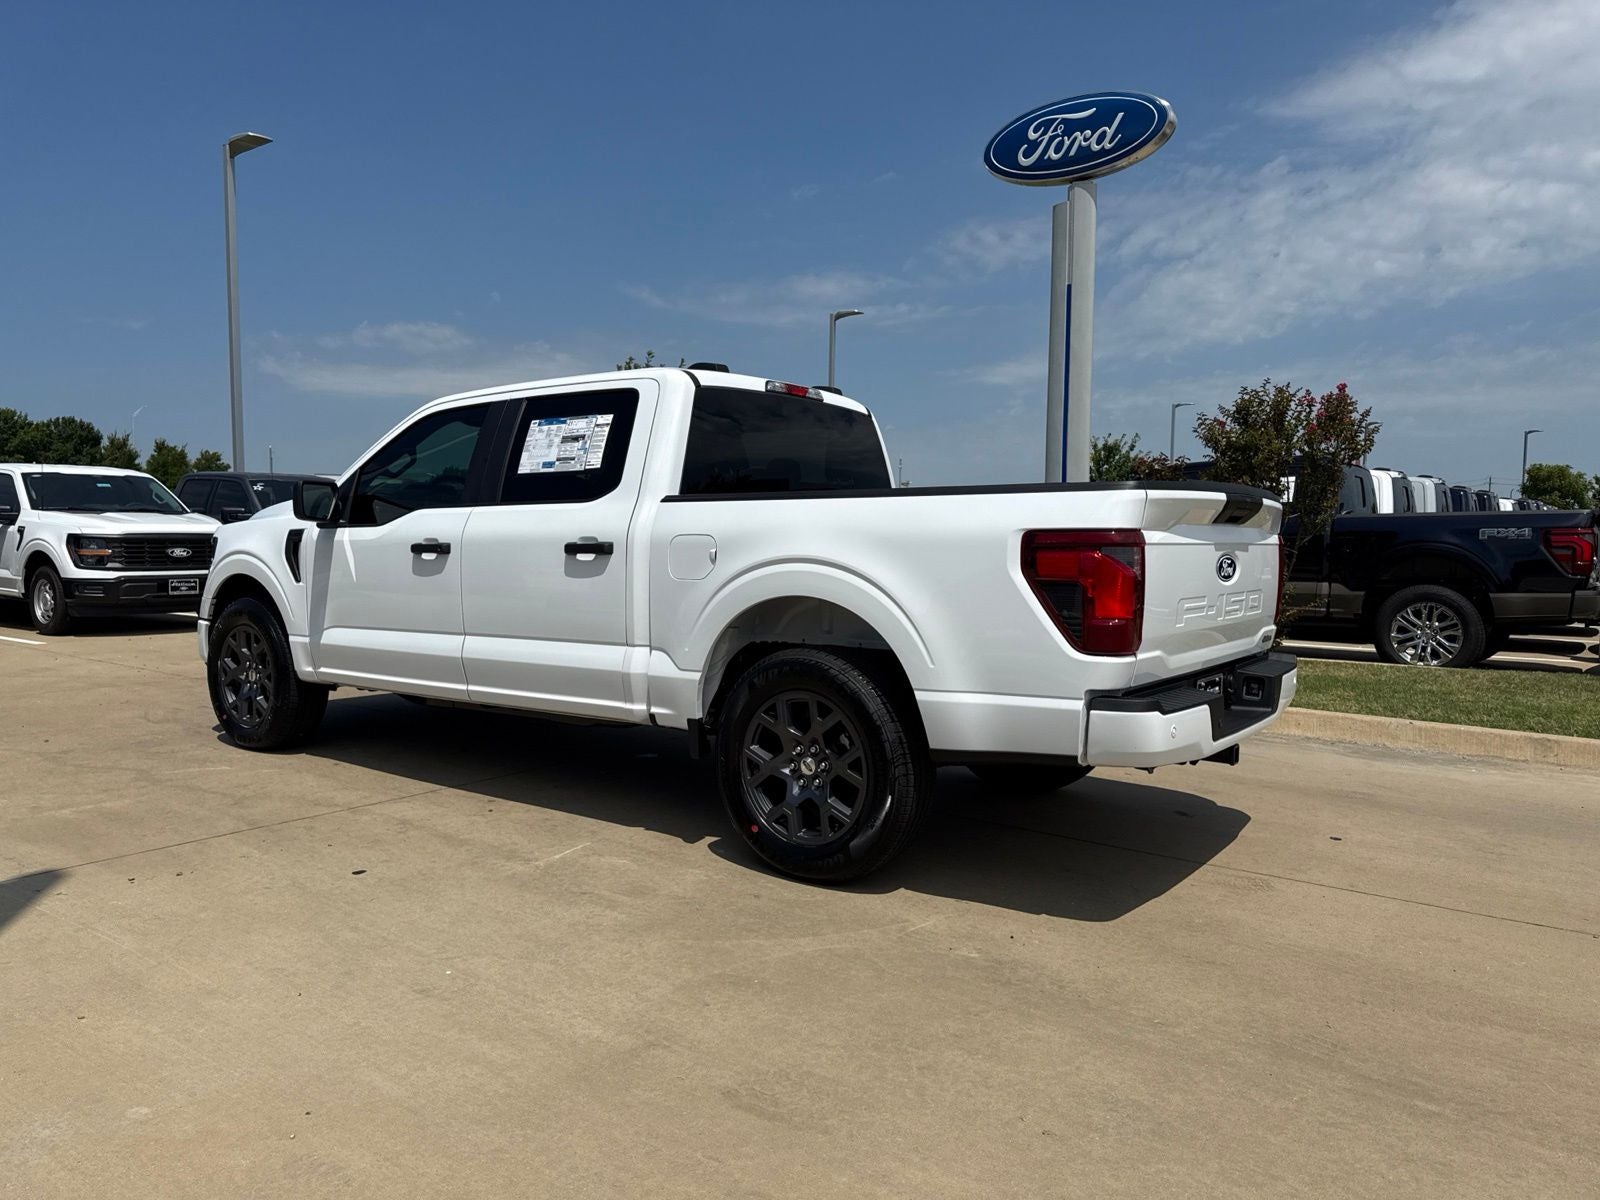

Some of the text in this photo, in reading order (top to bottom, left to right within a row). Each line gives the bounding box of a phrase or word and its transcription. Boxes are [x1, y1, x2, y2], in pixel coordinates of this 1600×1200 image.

[1017, 107, 1124, 166] Ford
[1479, 528, 1532, 540] FX4
[1220, 558, 1235, 577] Ford
[1176, 589, 1263, 627] F-150
